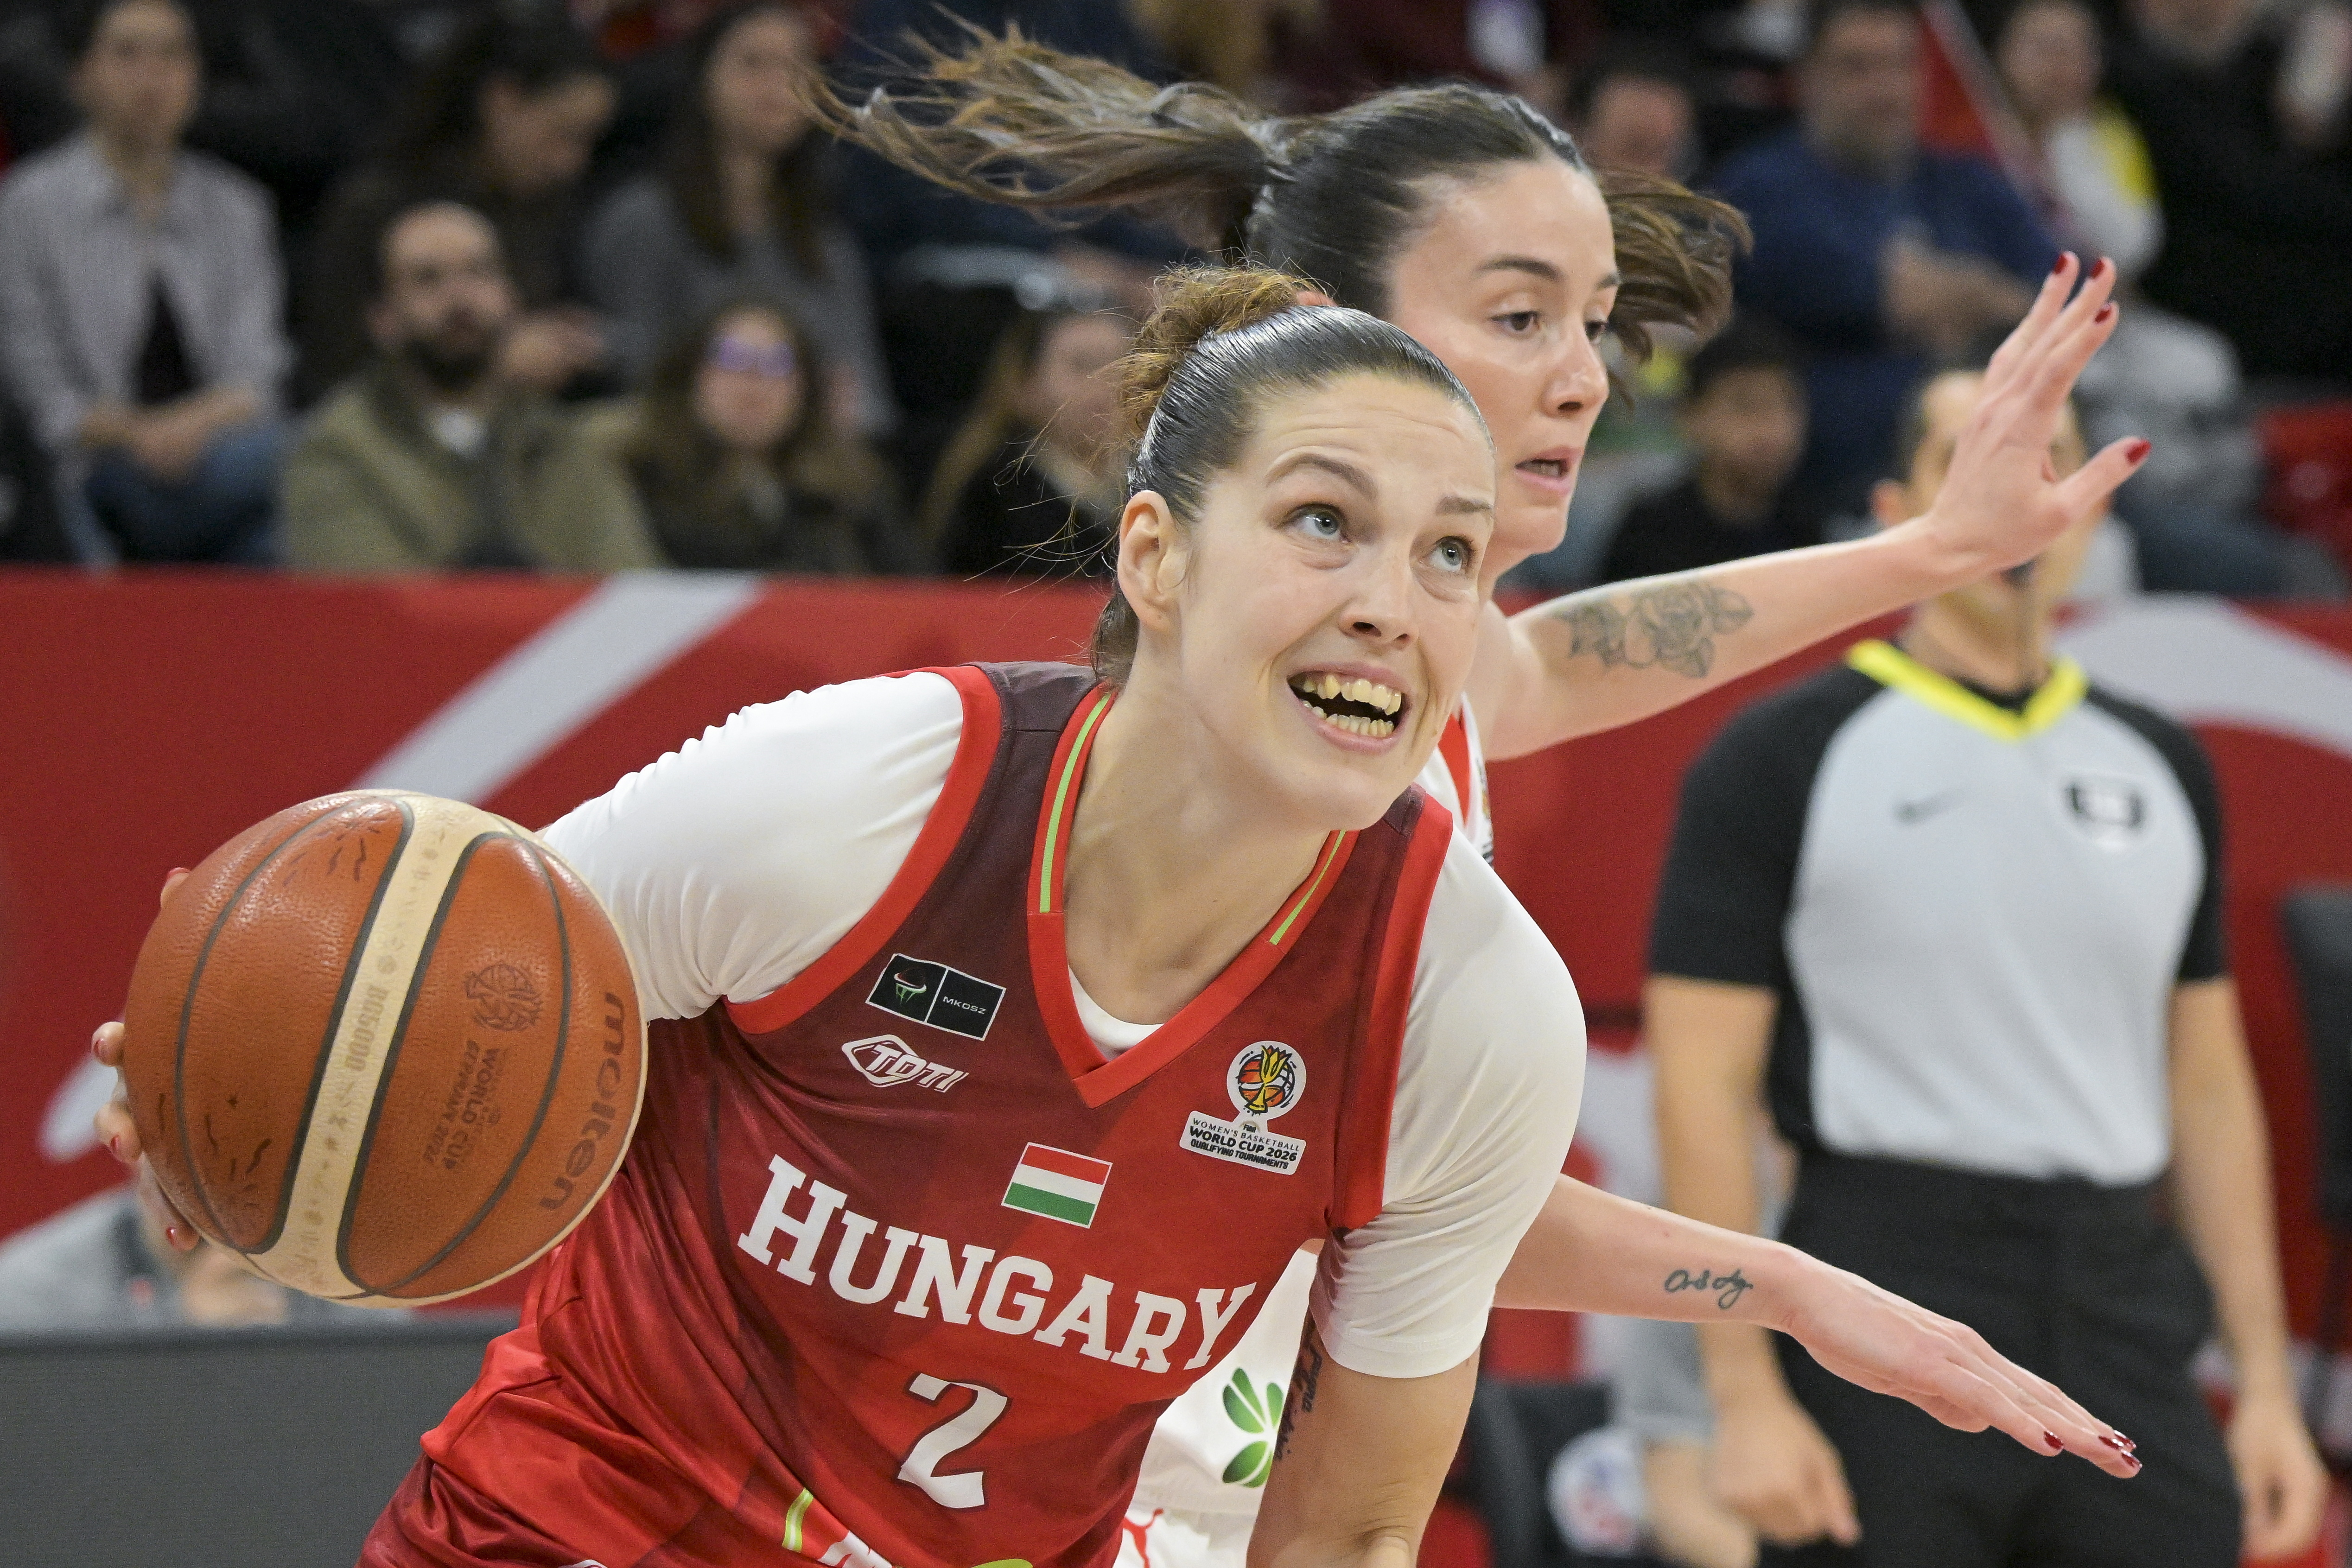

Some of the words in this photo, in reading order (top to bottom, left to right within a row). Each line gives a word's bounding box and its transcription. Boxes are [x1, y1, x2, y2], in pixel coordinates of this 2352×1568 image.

[942, 996, 986, 1014] MKOSZ
[462, 1048, 500, 1123] WORLD
[539, 992, 625, 1209] molten
[1190, 1126, 1236, 1147] WORLD
[1239, 1141, 1265, 1154] CUP
[1265, 1147, 1297, 1162] 2026
[1190, 1138, 1233, 1157] QUALIFYING
[1234, 1150, 1289, 1170] TOURNAMENTS
[1193, 1117, 1239, 1137] WOMEN'S
[1241, 1132, 1300, 1152] BASKETBALL
[737, 1154, 1257, 1373] HUNGARY
[897, 1372, 1008, 1509] 2
